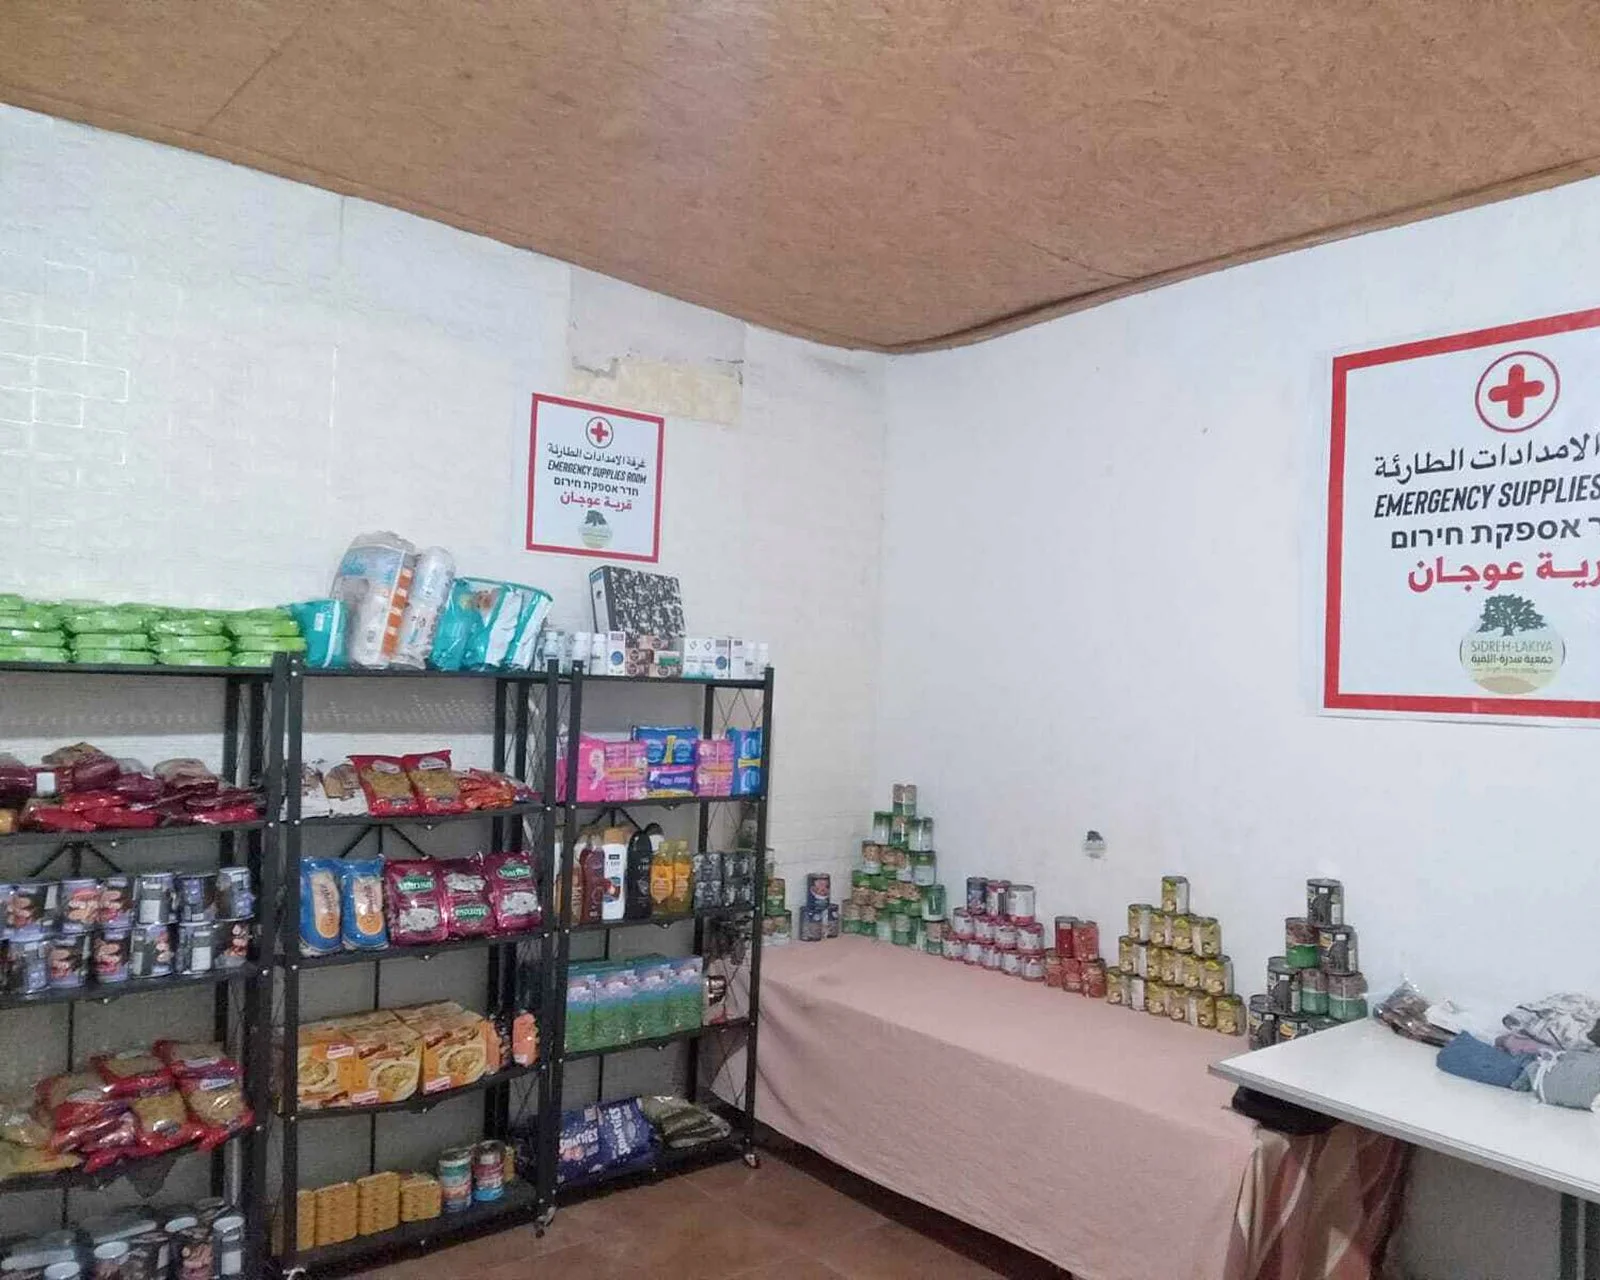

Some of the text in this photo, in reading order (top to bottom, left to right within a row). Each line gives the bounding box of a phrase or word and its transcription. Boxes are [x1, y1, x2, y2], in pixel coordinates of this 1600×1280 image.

[548, 460, 647, 484] EMERGENCY SUPPLIES ROOM
[1375, 447, 1464, 484] الطارئة
[554, 476, 639, 496] חדר אספקת חירום
[1374, 473, 1600, 518] EMERGENCY SUPPLIES
[1391, 518, 1581, 549] אספקת חירום
[1408, 556, 1524, 592] عوجان
